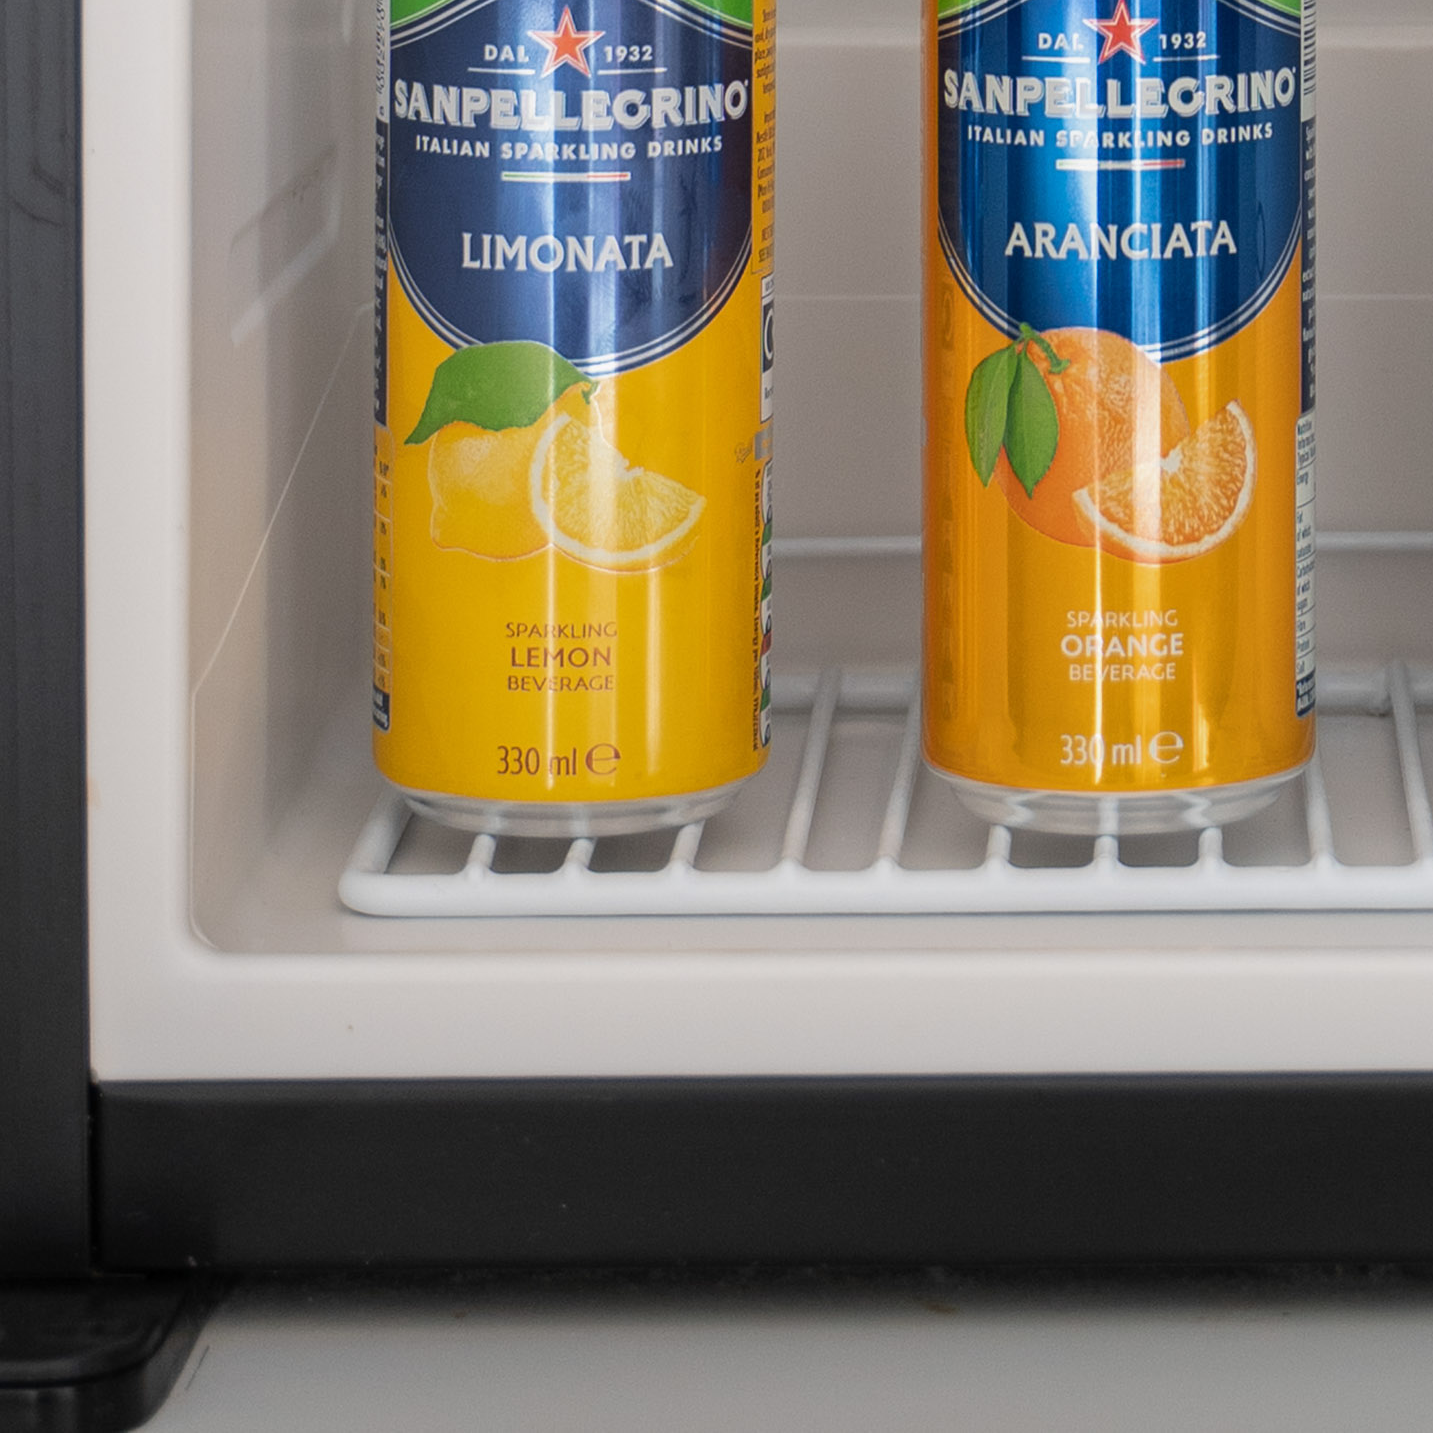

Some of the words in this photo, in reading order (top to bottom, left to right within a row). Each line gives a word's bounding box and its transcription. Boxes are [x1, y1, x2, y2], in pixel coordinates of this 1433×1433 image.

[1037, 32, 1084, 50] DAL
[1159, 31, 1207, 50] 1932
[484, 44, 529, 63] DAL
[603, 44, 653, 63] 1932
[394, 78, 748, 131] SANPELLEGRINO
[944, 68, 1297, 118] SANPELLEGRINO
[415, 135, 490, 157] ITALIAN
[501, 141, 636, 161] SPARKLING
[647, 135, 723, 158] DRINKS
[968, 125, 1045, 146] ITALIAN
[1056, 129, 1191, 149] SPARKLING
[1202, 122, 1273, 144] DRINKS
[462, 233, 673, 272] LIMONATA
[1004, 220, 1237, 260] ARANCIATA
[505, 621, 618, 639] SPARKLING
[1066, 609, 1178, 628] SPARKLING
[511, 647, 612, 668] LEMON
[1060, 633, 1184, 657] ORANGE
[507, 674, 615, 692] BEVERAGE
[1068, 664, 1176, 682] BEVERAGE
[496, 745, 541, 776] 330
[548, 746, 577, 776] ml
[1060, 733, 1105, 766] 330
[1111, 734, 1142, 765] ml
